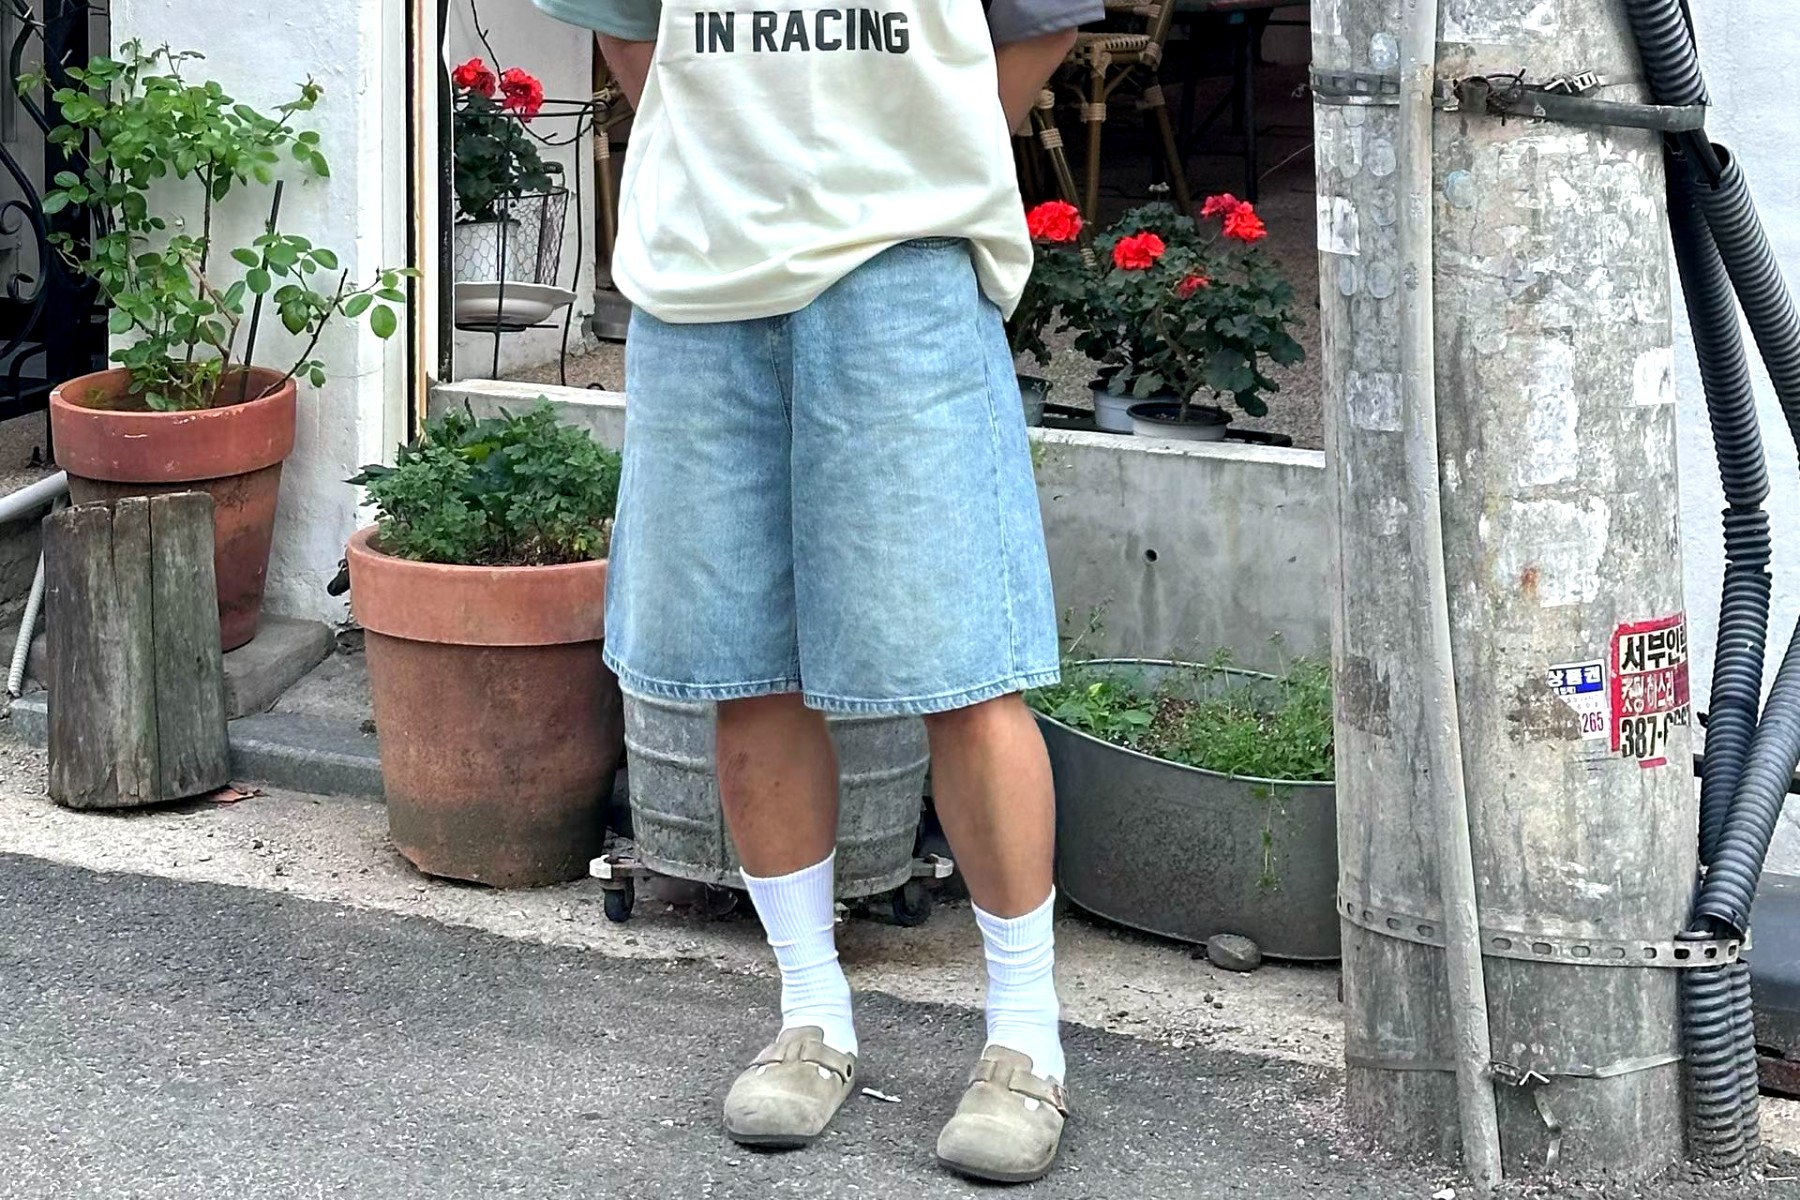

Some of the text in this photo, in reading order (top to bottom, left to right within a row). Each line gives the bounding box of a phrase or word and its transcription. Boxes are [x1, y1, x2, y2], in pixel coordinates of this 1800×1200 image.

[695, 8, 910, 54] IN RACING
[1582, 712, 1604, 733] 265
